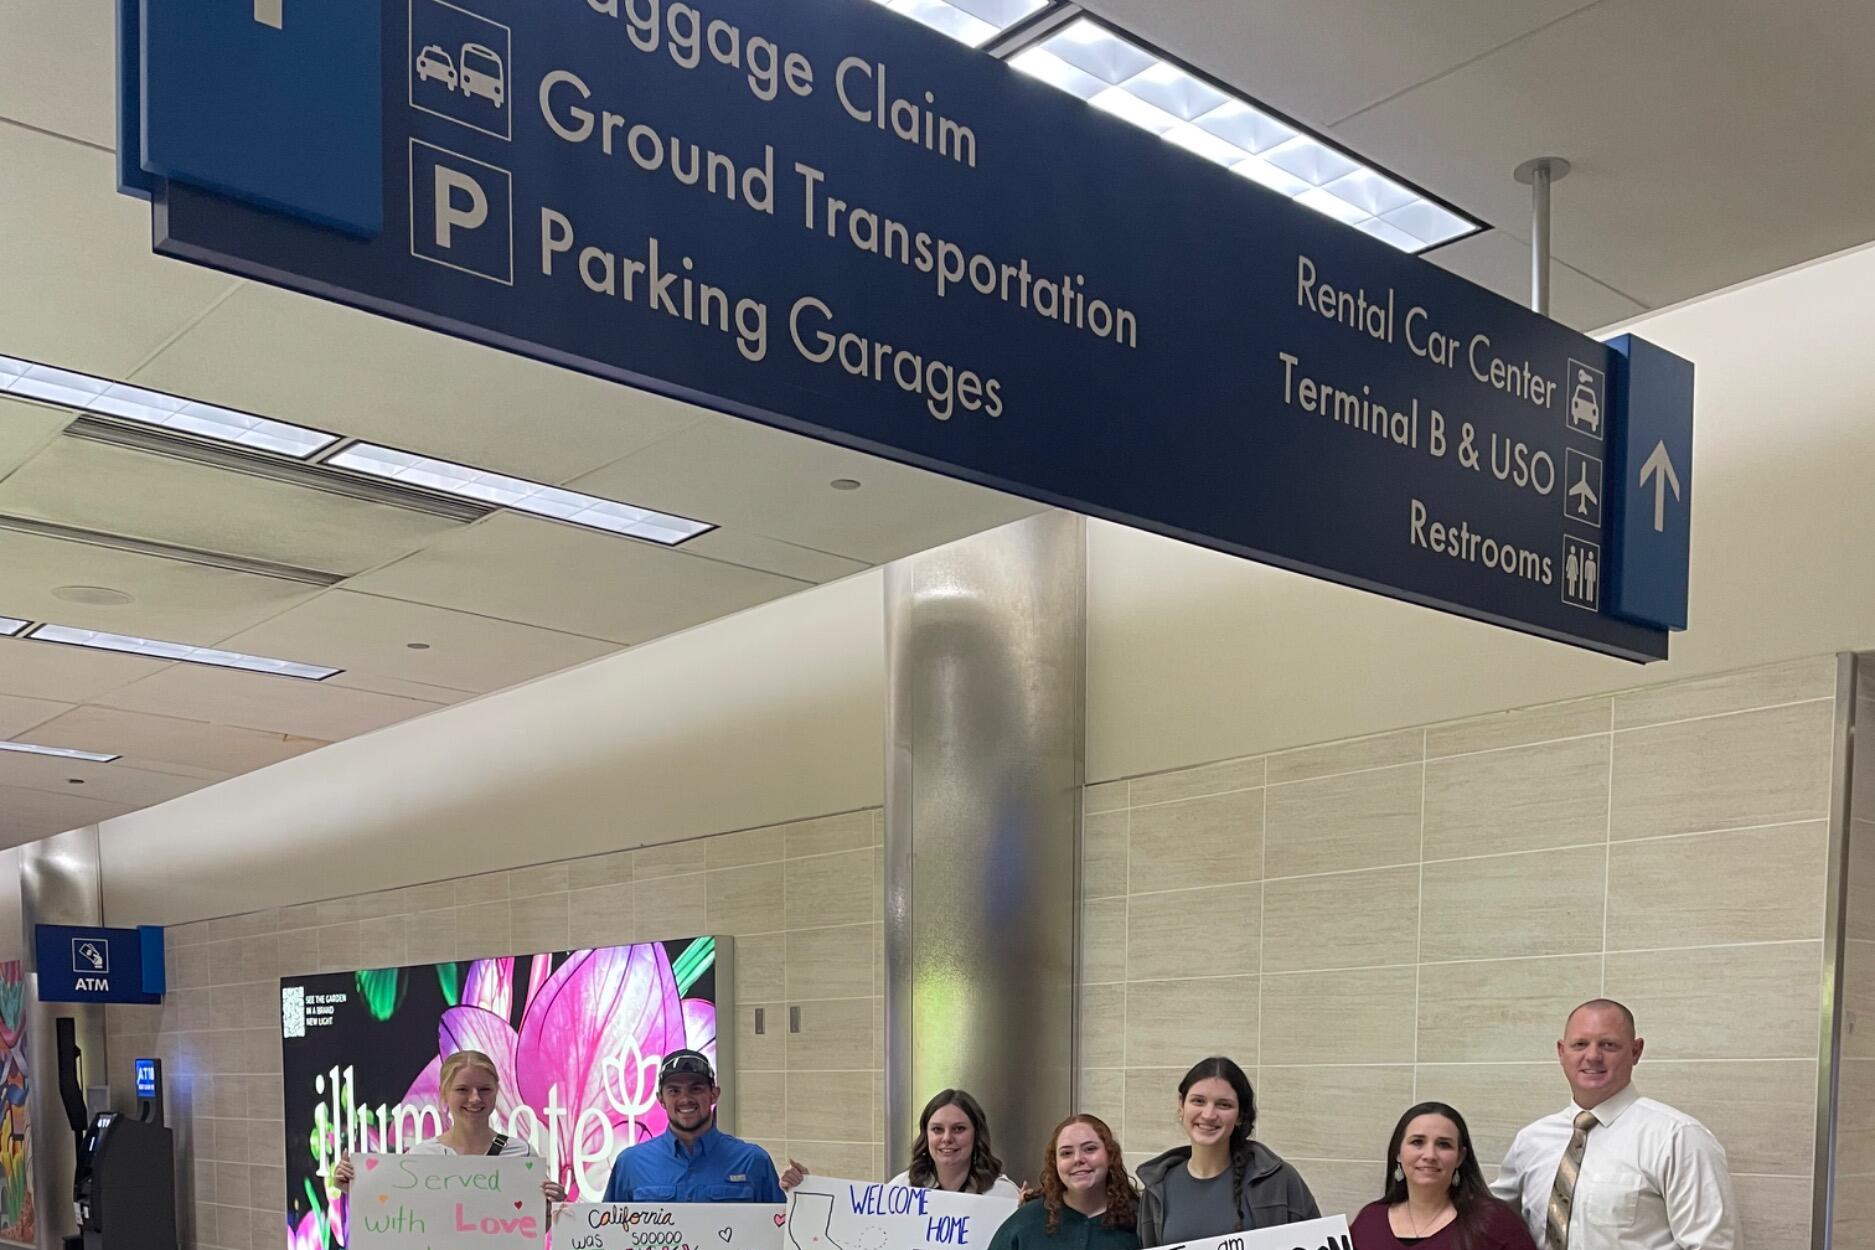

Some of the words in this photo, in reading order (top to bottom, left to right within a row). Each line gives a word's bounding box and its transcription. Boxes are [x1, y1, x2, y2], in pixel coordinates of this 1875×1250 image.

[586, 0, 814, 101] ggage
[835, 56, 977, 168] Claim
[538, 69, 774, 214] Ground
[793, 161, 1139, 348] Transportation
[539, 206, 767, 361] Parking
[789, 296, 1004, 421] Garages
[1297, 255, 1394, 344] Rental
[1404, 306, 1460, 369] Car
[1468, 334, 1557, 410] Center
[1279, 352, 1417, 449] Terminal
[1429, 410, 1447, 458] B
[1458, 421, 1481, 472] &
[1491, 432, 1556, 496] USO
[1410, 498, 1553, 586] Restrooms
[75, 978, 109, 992] ATM
[305, 995, 315, 1004] SEE
[315, 995, 325, 1003] THE
[326, 994, 346, 1003] GARDEN
[306, 1007, 312, 1015] IN
[316, 1006, 334, 1015] BRAND
[306, 1017, 317, 1025] NEW
[318, 1017, 333, 1025] LIGHT
[392, 1159, 502, 1192] Served
[849, 1184, 929, 1216] WELCOME
[364, 1205, 425, 1234] with
[455, 1202, 538, 1239] Love
[588, 1205, 676, 1233] California
[926, 1216, 971, 1244] HOME
[571, 1233, 604, 1250] was
